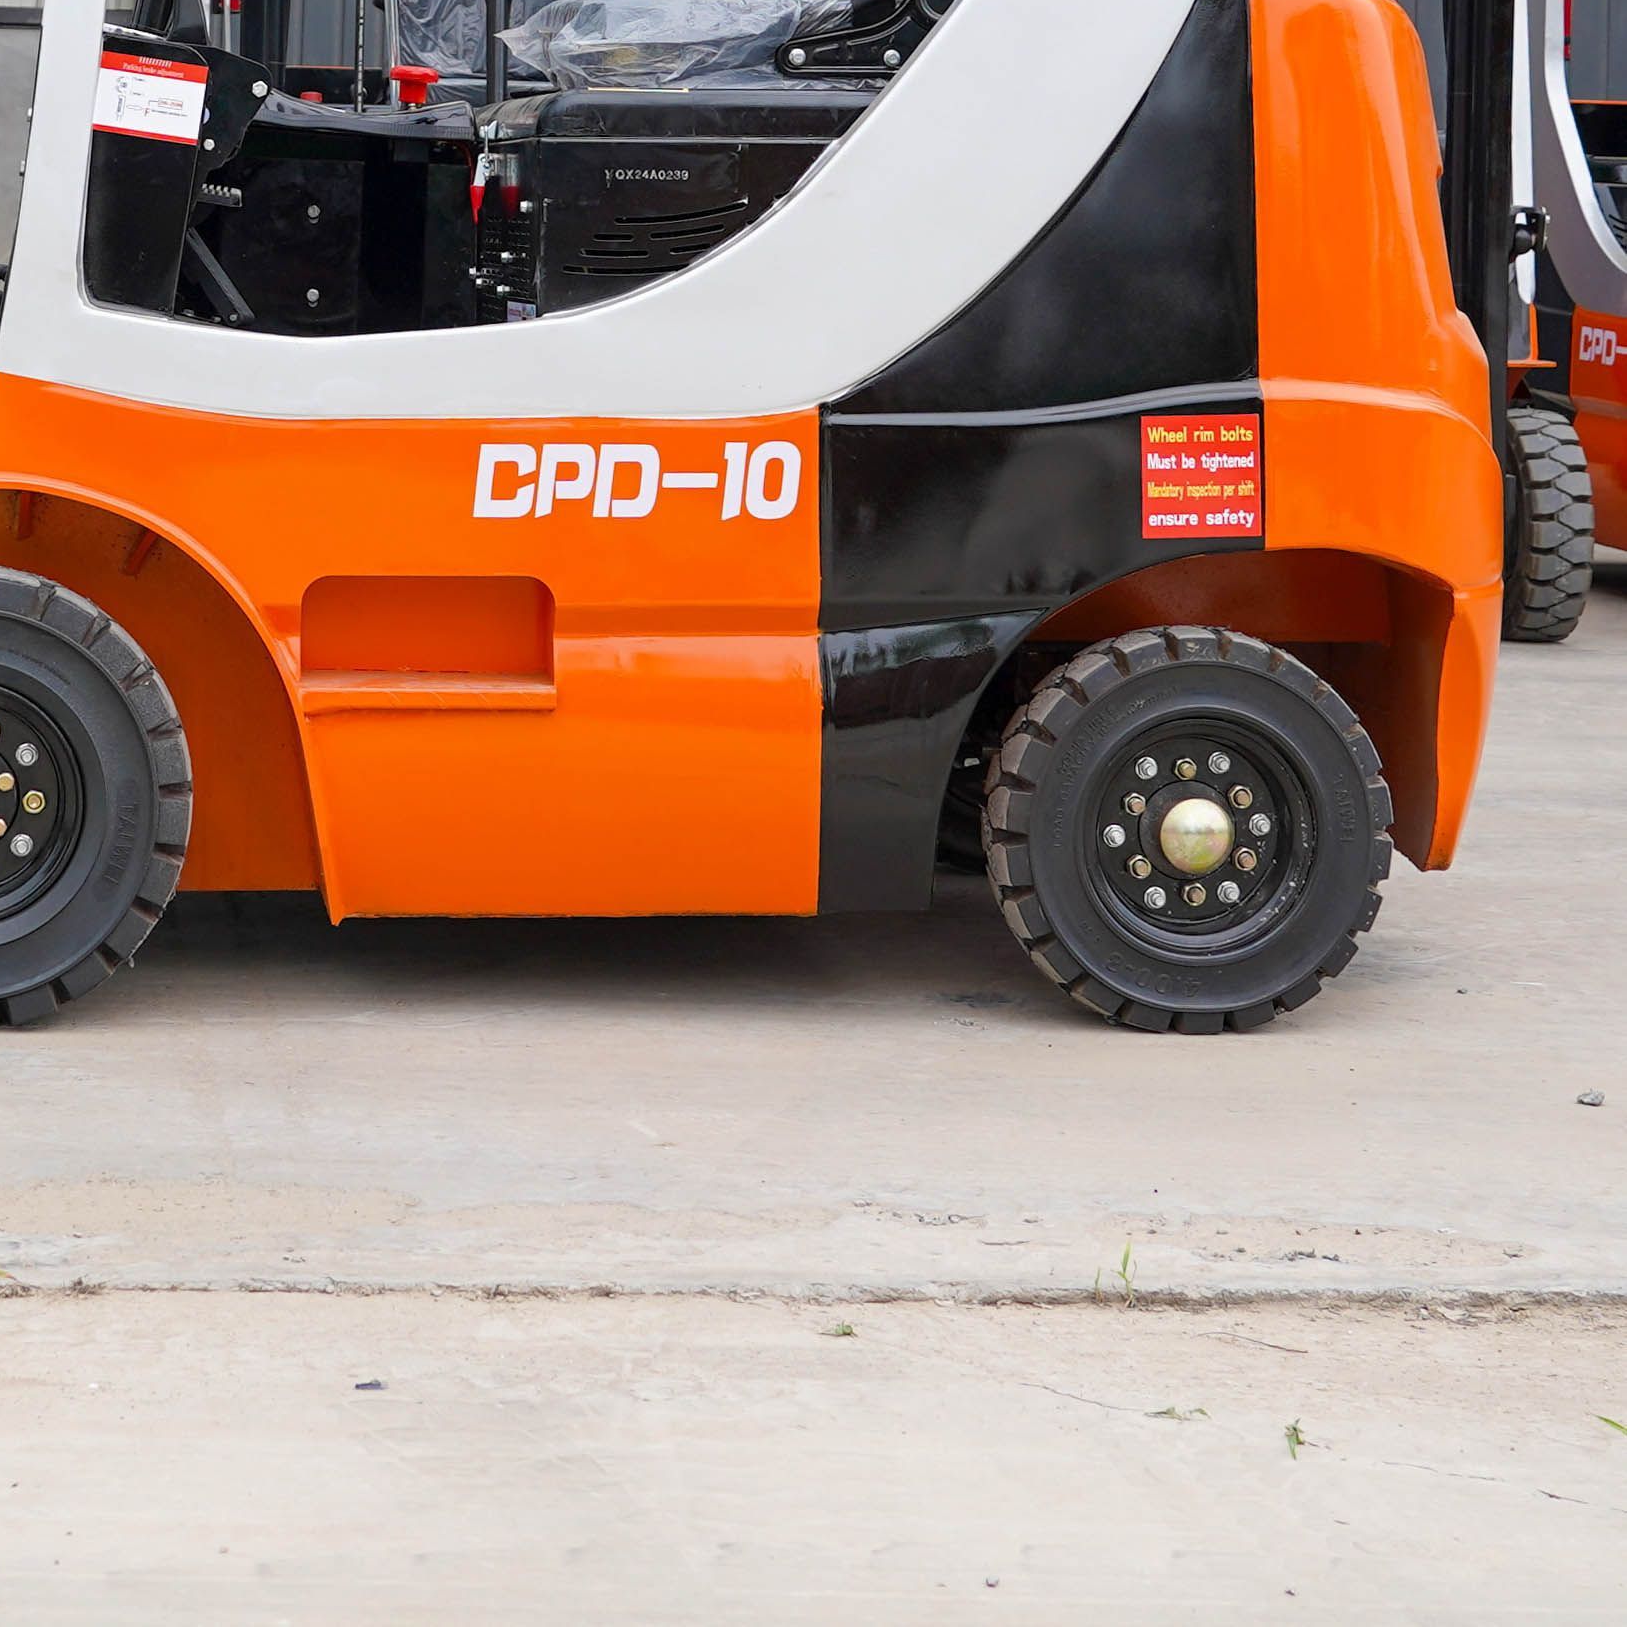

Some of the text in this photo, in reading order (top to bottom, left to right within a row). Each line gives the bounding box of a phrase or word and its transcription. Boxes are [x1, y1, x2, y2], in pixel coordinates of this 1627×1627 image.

[1147, 425, 1253, 443] Wheel rim bolts
[1147, 451, 1254, 472] Must be tightened
[472, 440, 802, 521] CPD-10
[1147, 480, 1254, 501] Mandatory inspection per shift
[1148, 508, 1255, 528] ensure safety
